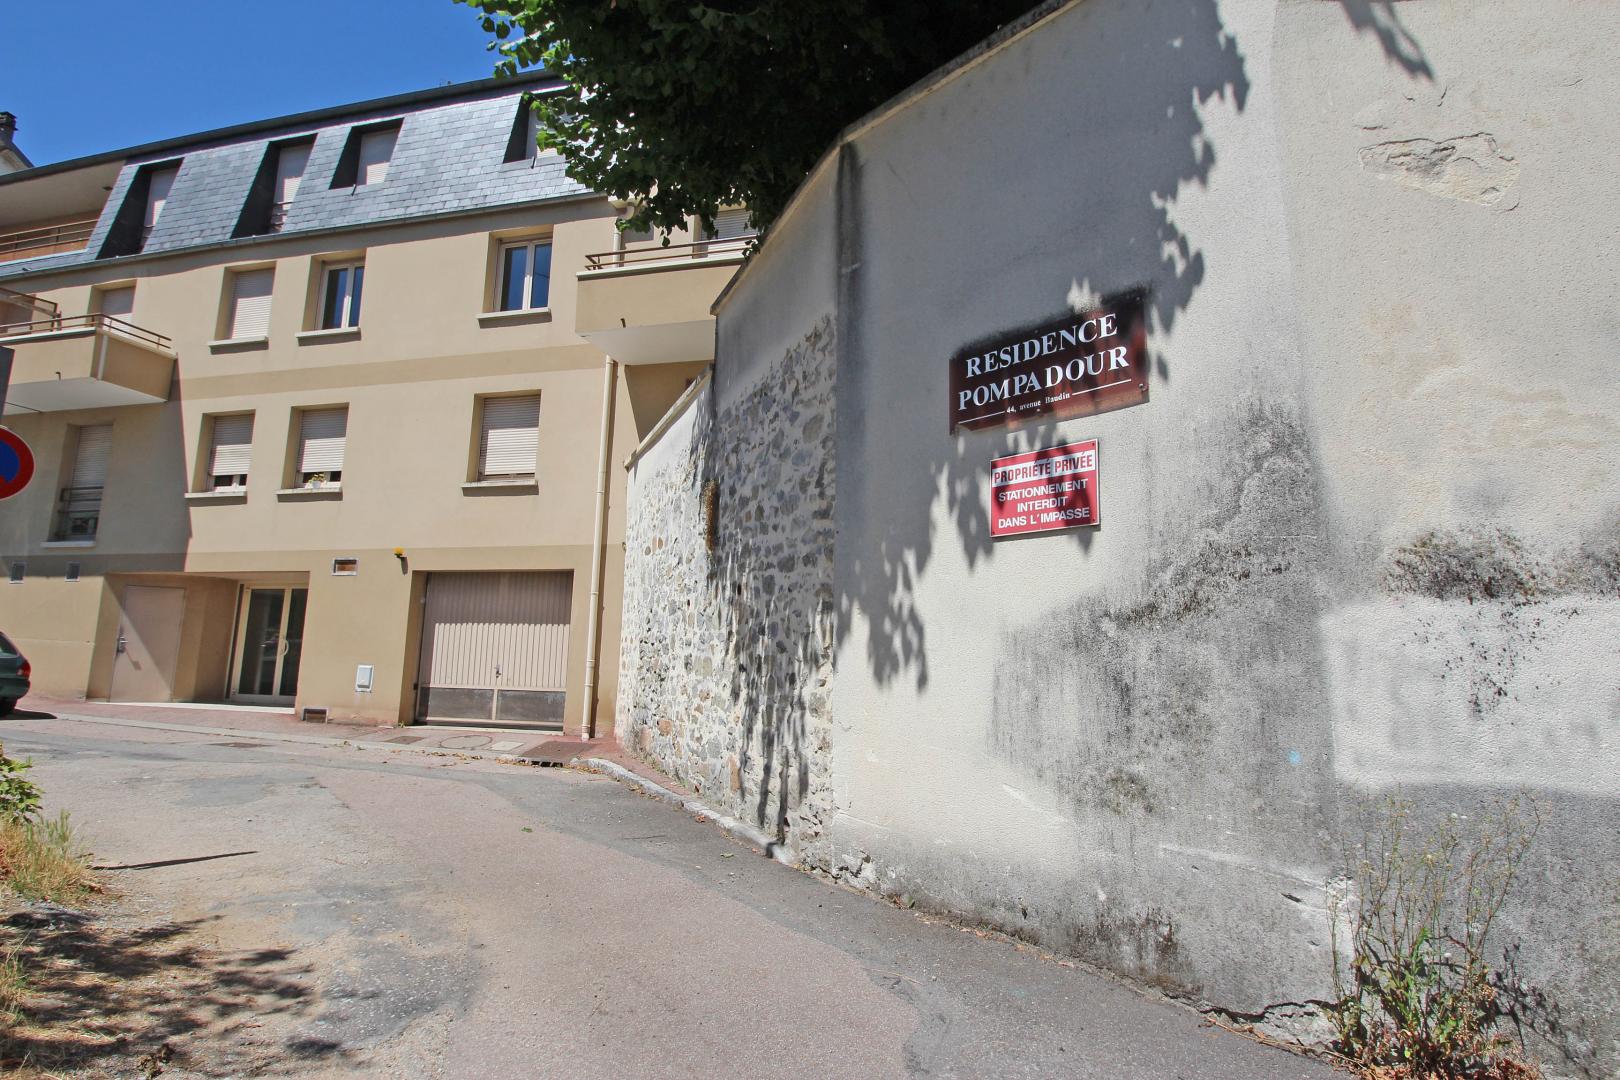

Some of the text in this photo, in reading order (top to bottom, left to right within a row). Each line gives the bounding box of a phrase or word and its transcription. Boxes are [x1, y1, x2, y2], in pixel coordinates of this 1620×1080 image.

[966, 313, 1118, 378] RESIDENCE
[958, 346, 1130, 411] POMPADOUR
[1019, 400, 1041, 411] avenue
[1045, 392, 1070, 404] Baudin
[994, 451, 1093, 483] PROPRIÉTÉ PRIVÉE
[998, 479, 1089, 501] STATIONNEMENT
[1017, 496, 1068, 512] INTERDIT
[998, 516, 1027, 528] DANS
